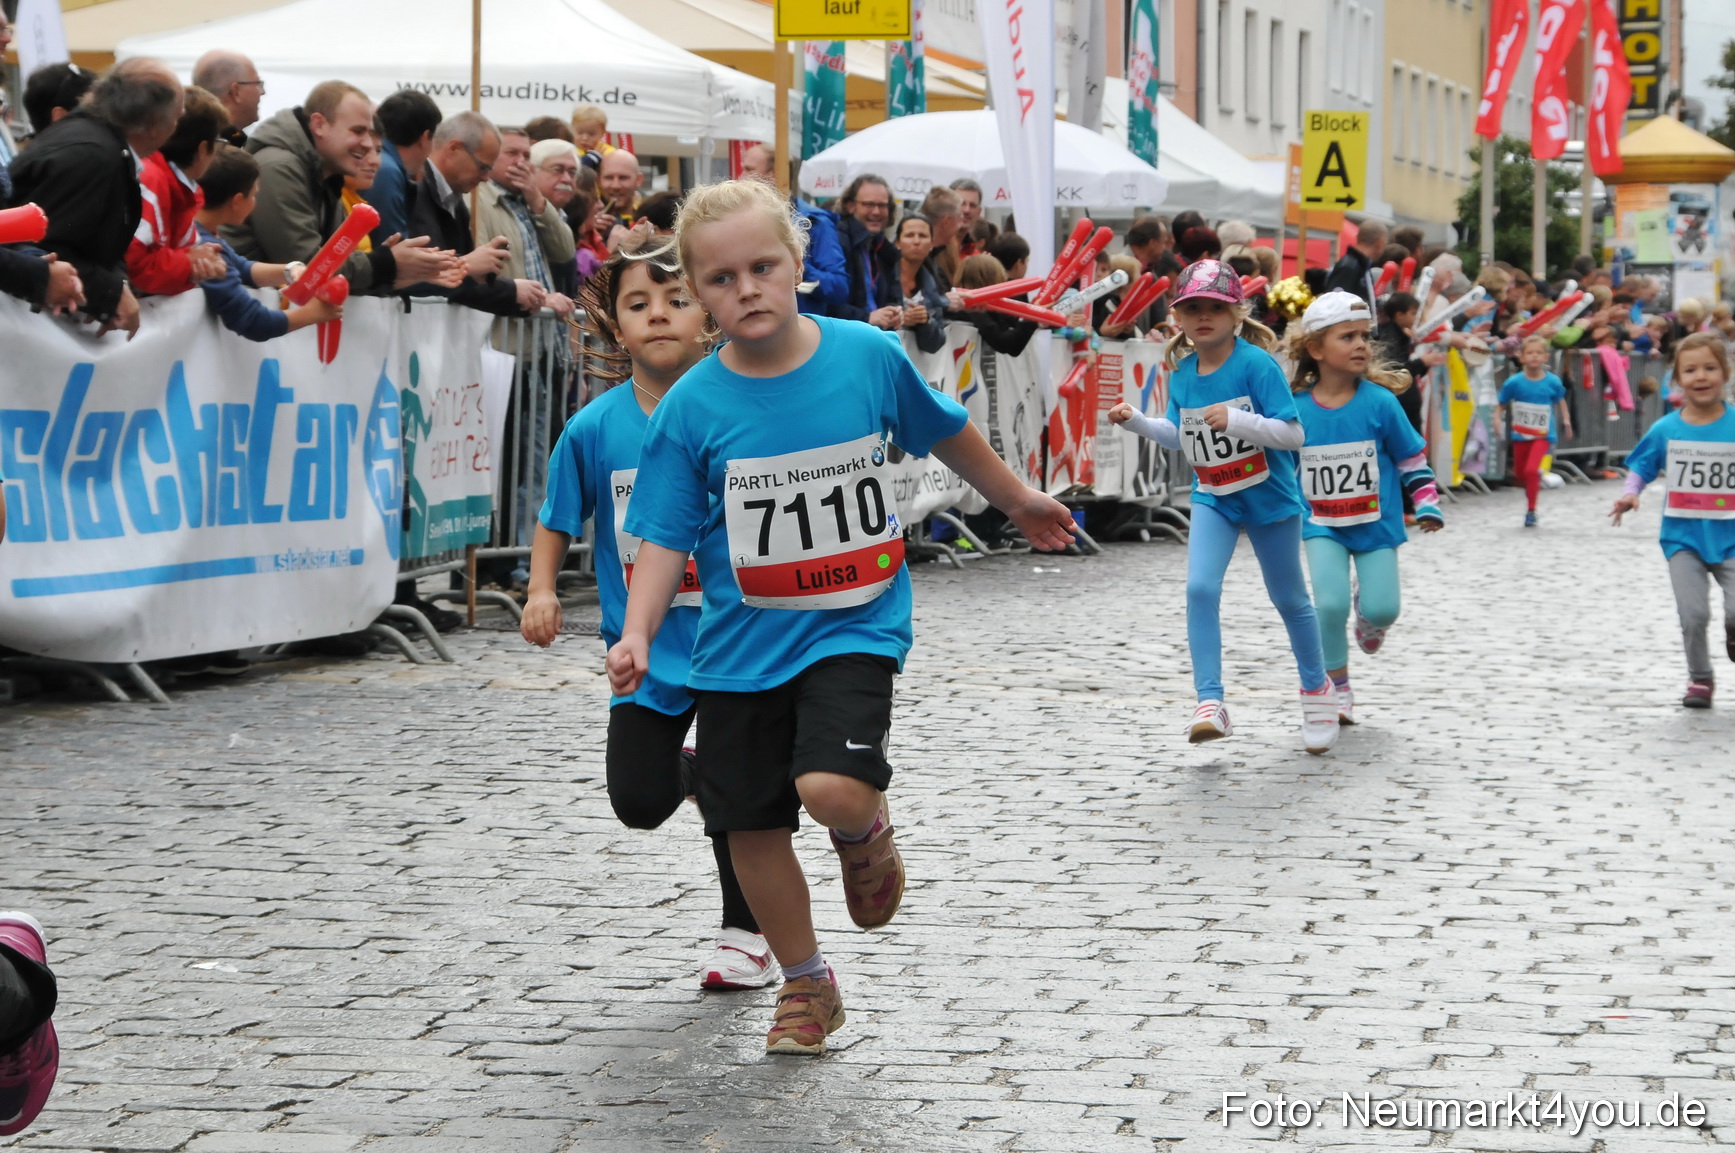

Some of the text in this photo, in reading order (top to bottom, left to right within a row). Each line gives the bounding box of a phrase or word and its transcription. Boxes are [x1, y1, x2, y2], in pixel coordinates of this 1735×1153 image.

[823, 0, 862, 15] lauf
[396, 81, 637, 106] wwwaudibkk.de
[1311, 113, 1361, 131] Block
[1314, 140, 1351, 188] A
[1185, 429, 1255, 462] 7152
[1321, 450, 1363, 462] Neumarkt
[729, 456, 867, 491] PARTL Neumarkt
[1307, 462, 1373, 496] 7024
[1675, 461, 1735, 489] 7588
[743, 477, 887, 557] 7110
[795, 564, 858, 590] Luisa
